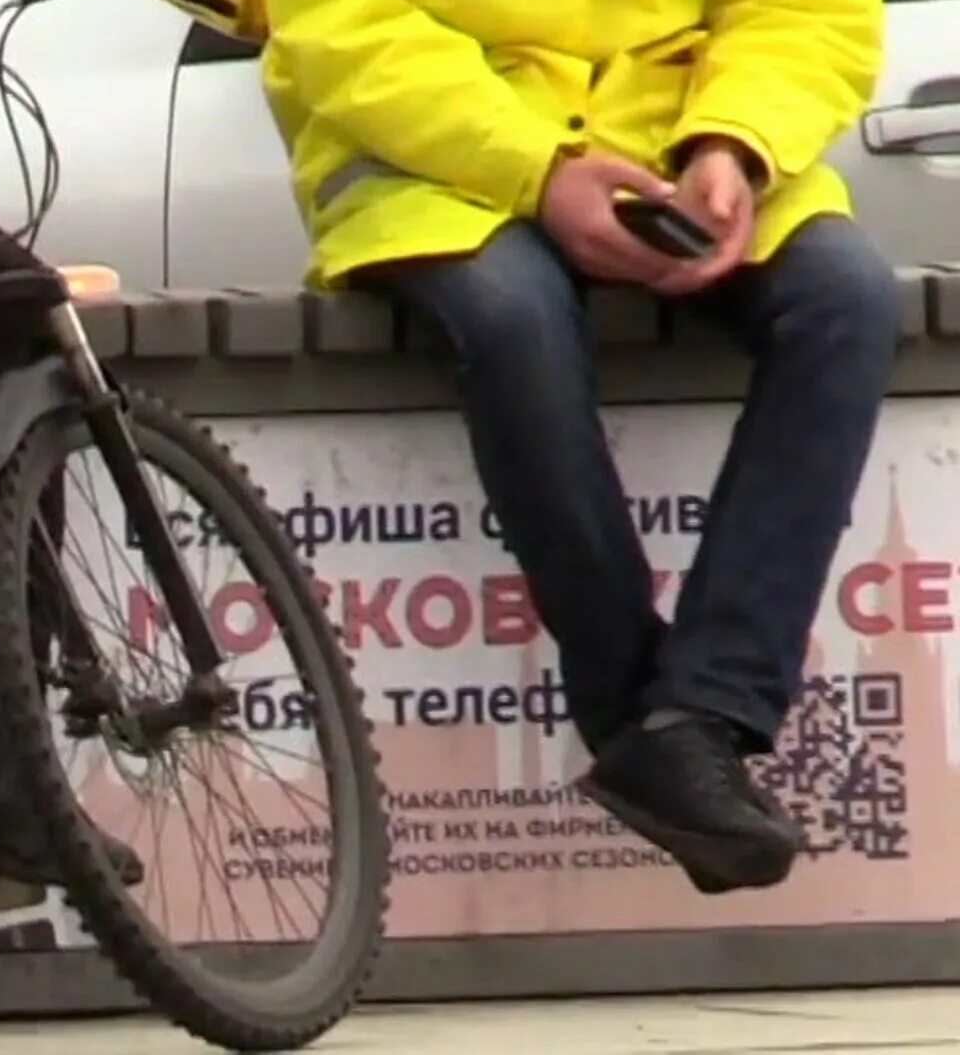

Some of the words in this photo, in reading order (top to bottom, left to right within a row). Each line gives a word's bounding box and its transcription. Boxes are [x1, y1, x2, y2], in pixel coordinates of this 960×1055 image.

[281, 492, 460, 557] фиша
[837, 561, 955, 635] СЕ
[383, 668, 572, 737] телеф
[486, 818, 520, 840] НА
[525, 815, 626, 838] ФИРМЕ
[570, 846, 678, 869] СЕЗОНО
